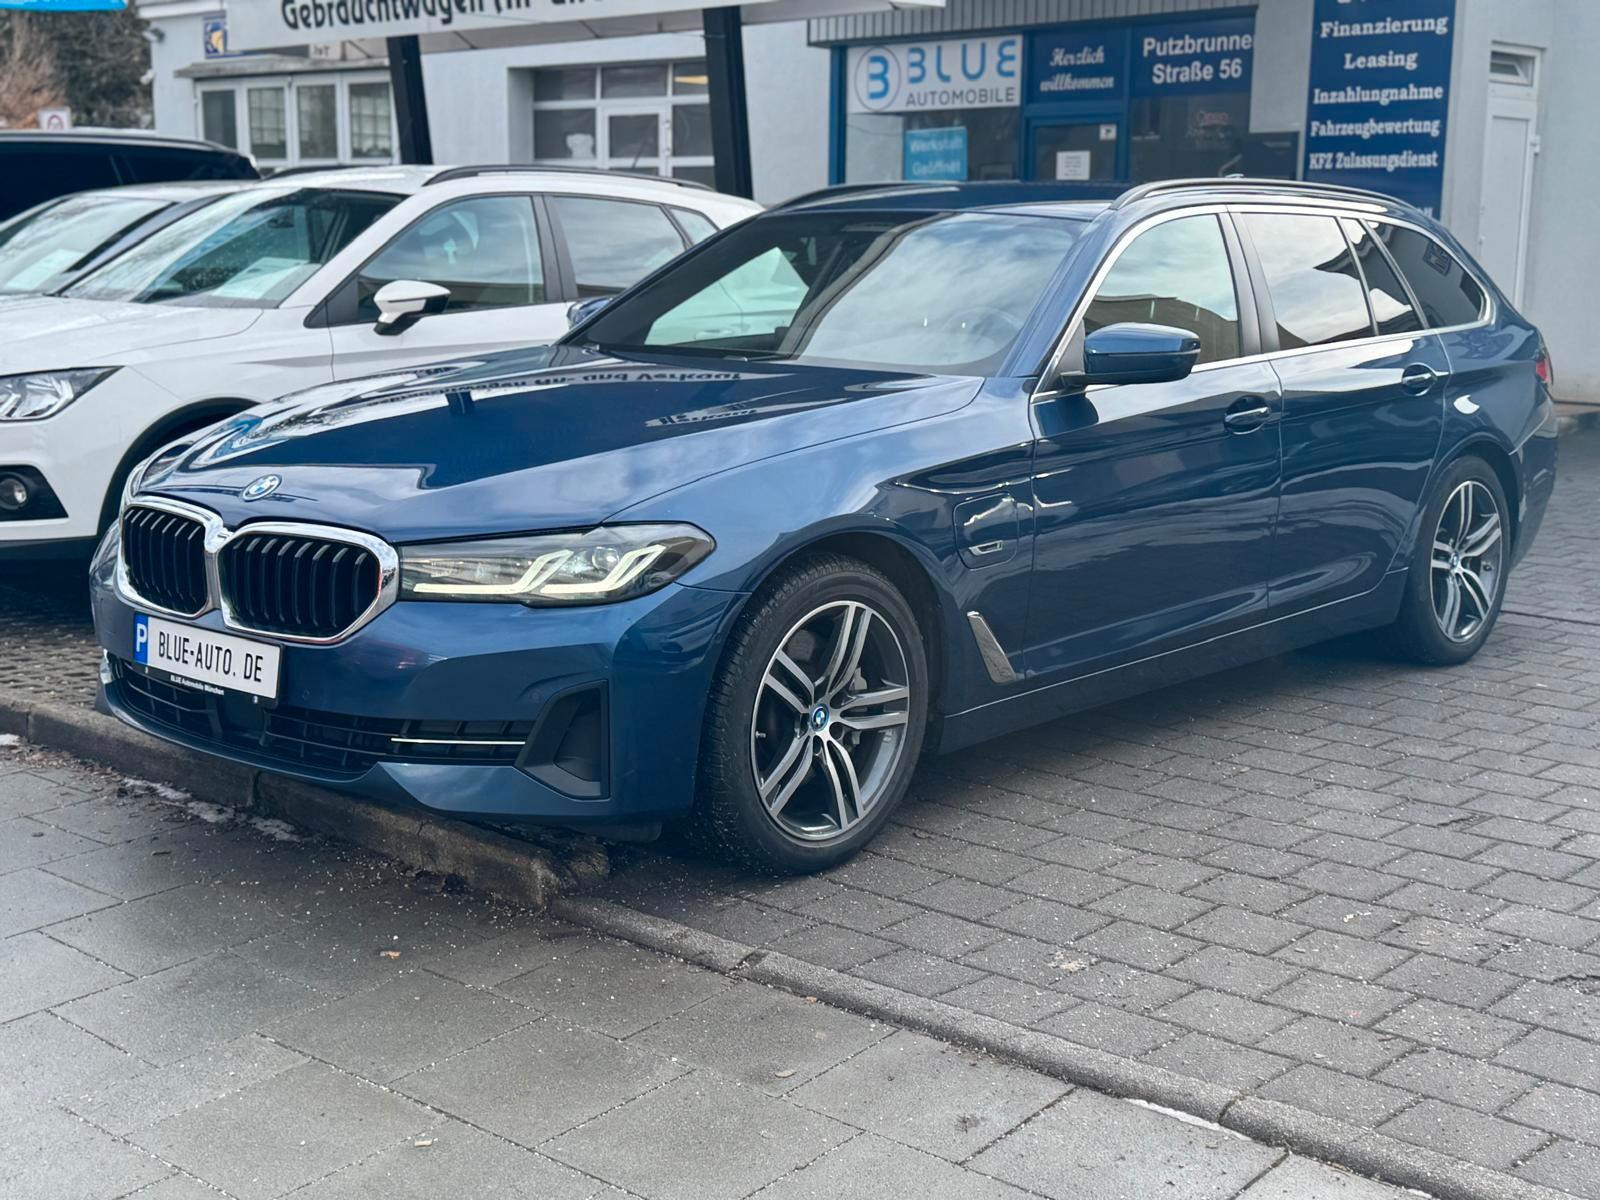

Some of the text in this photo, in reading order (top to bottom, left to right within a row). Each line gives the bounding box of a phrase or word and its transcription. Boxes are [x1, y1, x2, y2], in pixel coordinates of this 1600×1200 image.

[1320, 16, 1449, 38] Finanzierung
[1143, 34, 1254, 58] Putzbrunne
[907, 39, 1017, 84] BLUE
[1152, 58, 1243, 84] Straße 56
[1344, 50, 1419, 71] Leasing
[905, 87, 1016, 108] AUTOMOBILE
[1313, 83, 1444, 106] Inzahlungnahme
[1310, 118, 1441, 140] Fahrzeugbewertung
[1309, 150, 1439, 173] KFZ Zulassungsdienst
[243, 653, 264, 683] DE
